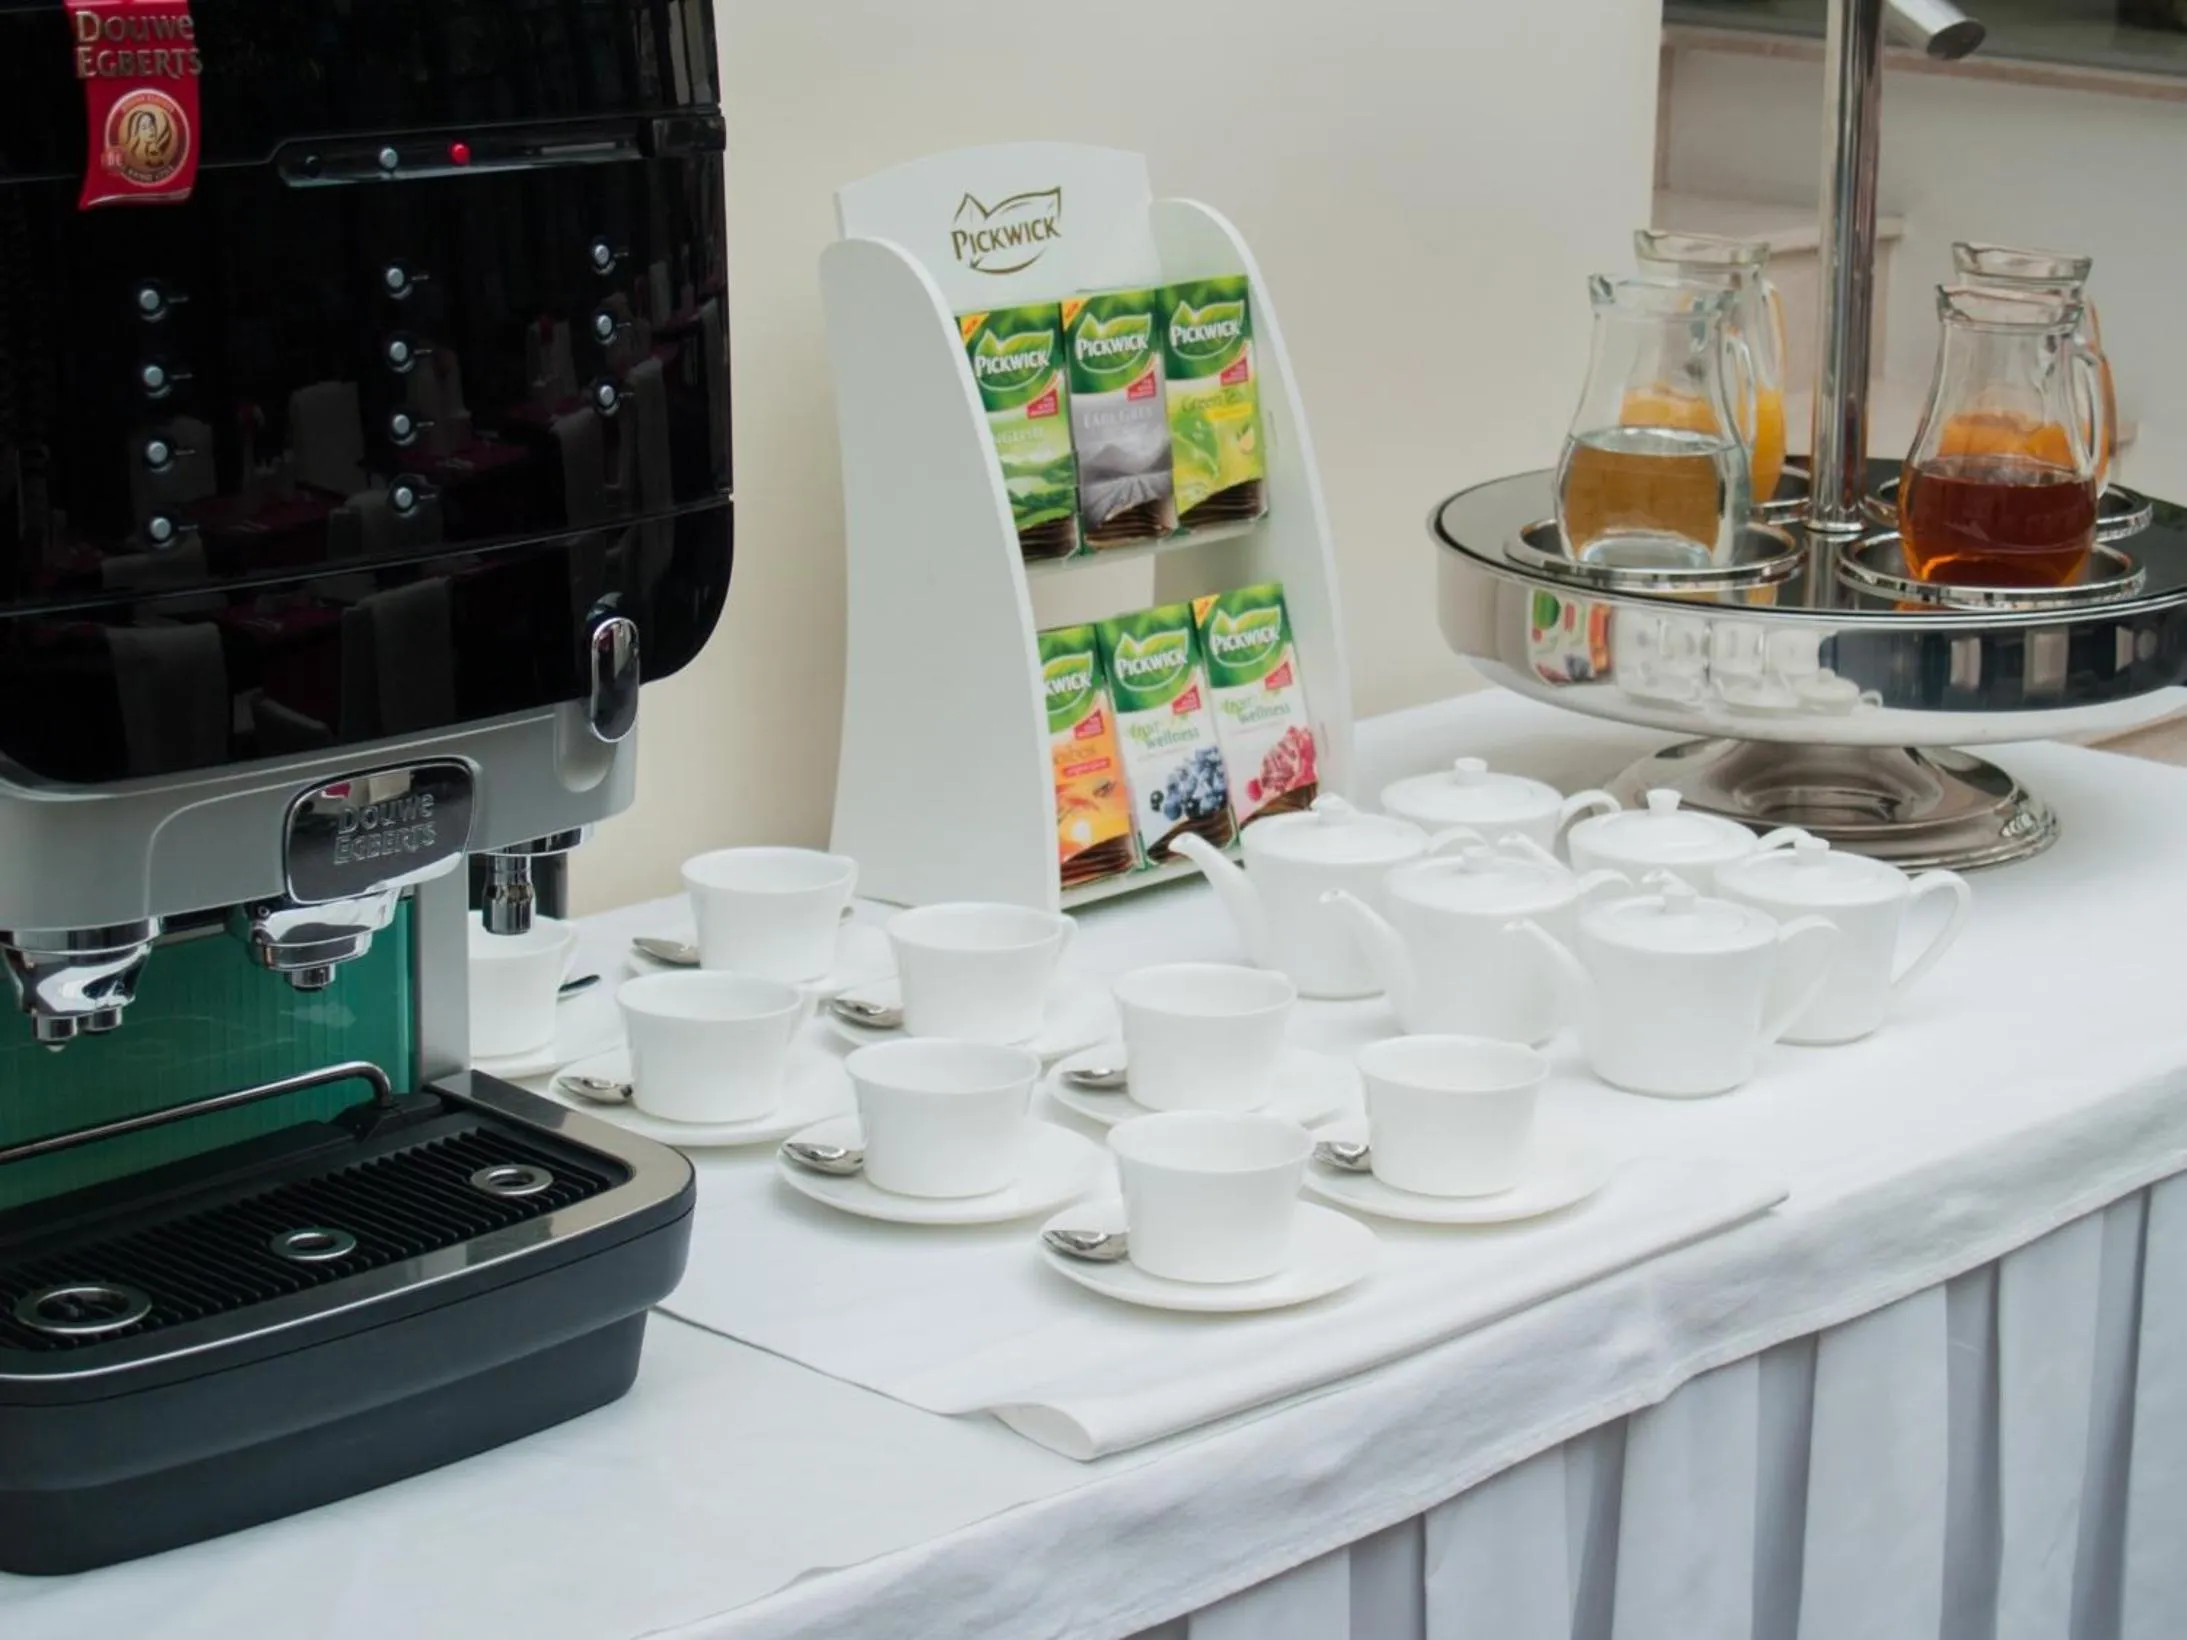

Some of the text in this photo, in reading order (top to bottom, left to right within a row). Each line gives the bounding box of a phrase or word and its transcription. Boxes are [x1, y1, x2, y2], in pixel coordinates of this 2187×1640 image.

[75, 10, 195, 43] Douwe
[75, 46, 203, 79] EGBERTS
[951, 215, 1062, 261] PICKWICK
[1075, 331, 1149, 361] PICKWICK
[1170, 320, 1243, 347] PICKWICK
[974, 349, 1050, 378] PICKWICK
[1210, 624, 1280, 656] PICKWICK
[1117, 646, 1188, 681] PICKWICK
[1044, 670, 1091, 697] KWICK
